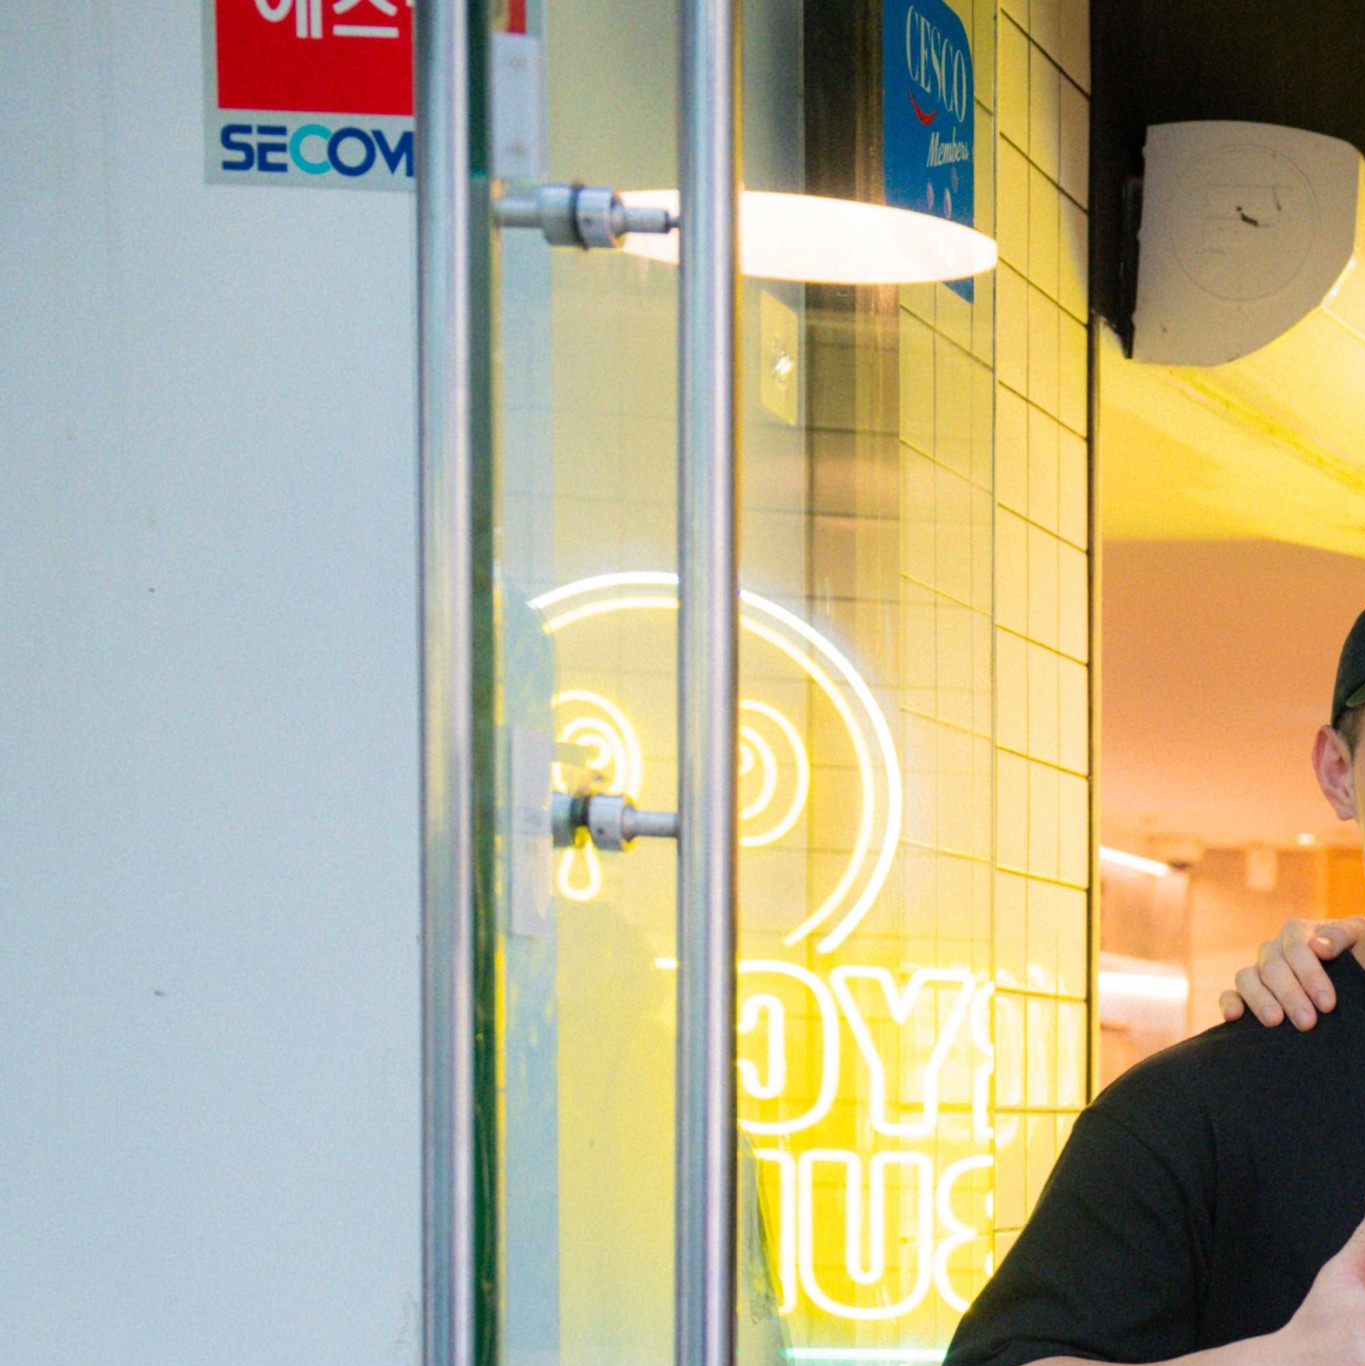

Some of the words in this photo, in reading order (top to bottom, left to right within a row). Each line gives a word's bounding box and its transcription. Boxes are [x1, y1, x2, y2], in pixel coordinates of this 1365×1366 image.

[255, 0, 413, 39] 에스
[905, 5, 967, 124] CESCO
[220, 123, 414, 178] SECOM
[927, 127, 970, 168] Members
